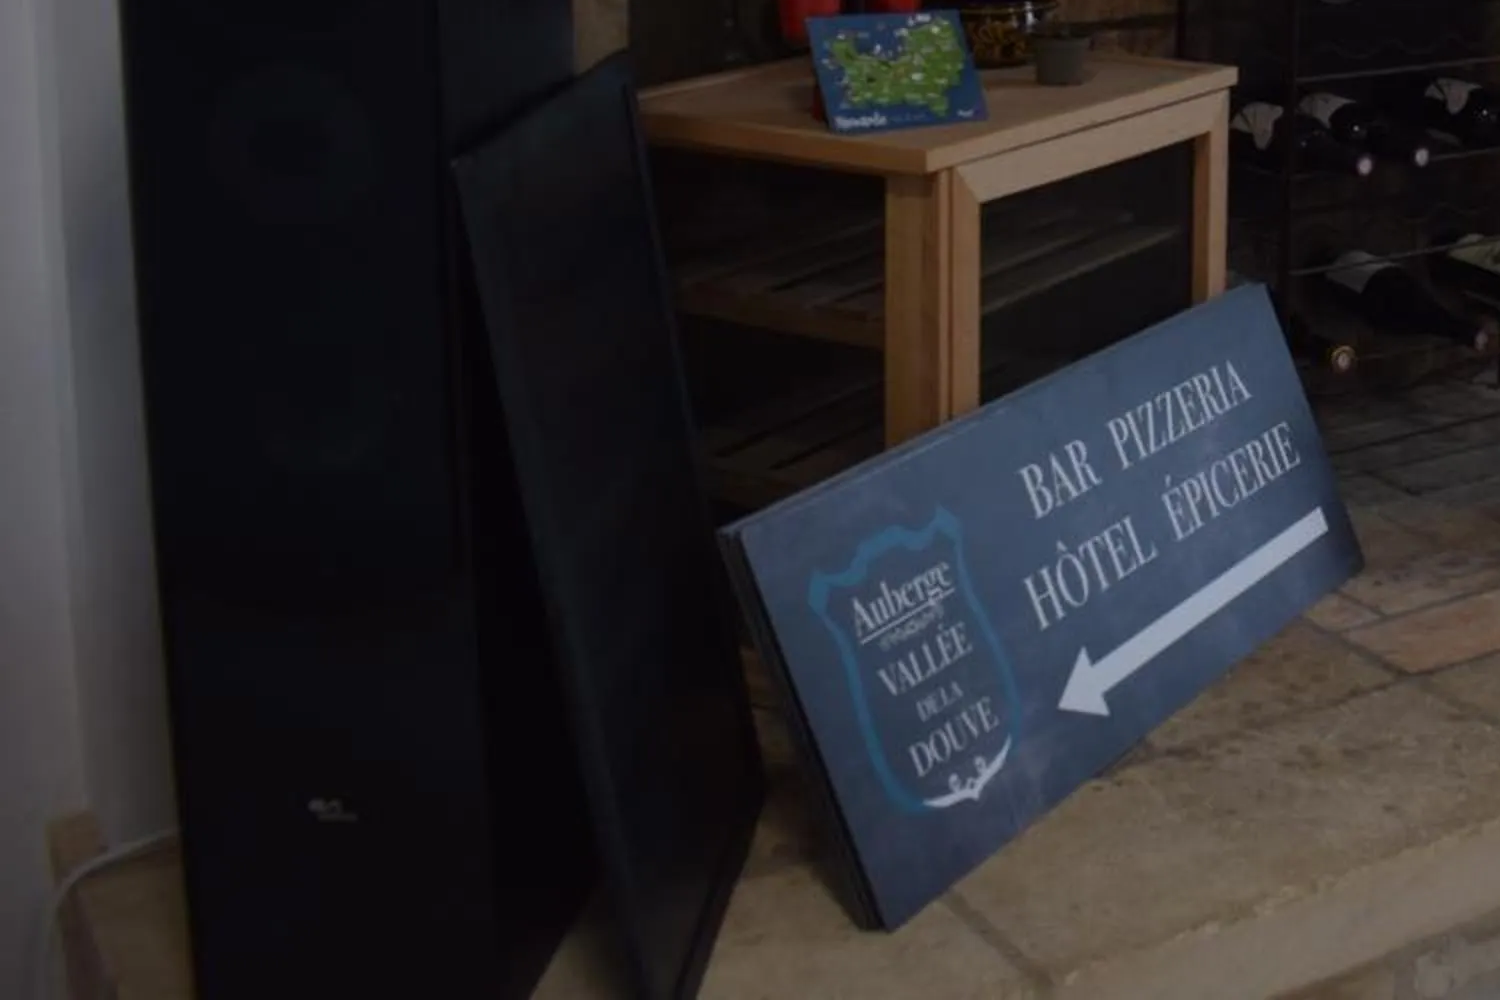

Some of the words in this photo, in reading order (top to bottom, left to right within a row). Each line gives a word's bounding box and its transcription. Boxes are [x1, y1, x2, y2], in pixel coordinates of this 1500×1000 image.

[1016, 438, 1103, 521] BAR
[1105, 359, 1254, 471] PIZZERIA
[1023, 515, 1159, 632] HÔTEL
[1160, 420, 1301, 543] ÉPICERIE
[852, 562, 953, 638] Auberge
[876, 621, 974, 697] VALLÉE
[908, 696, 1000, 778] DOUVE
